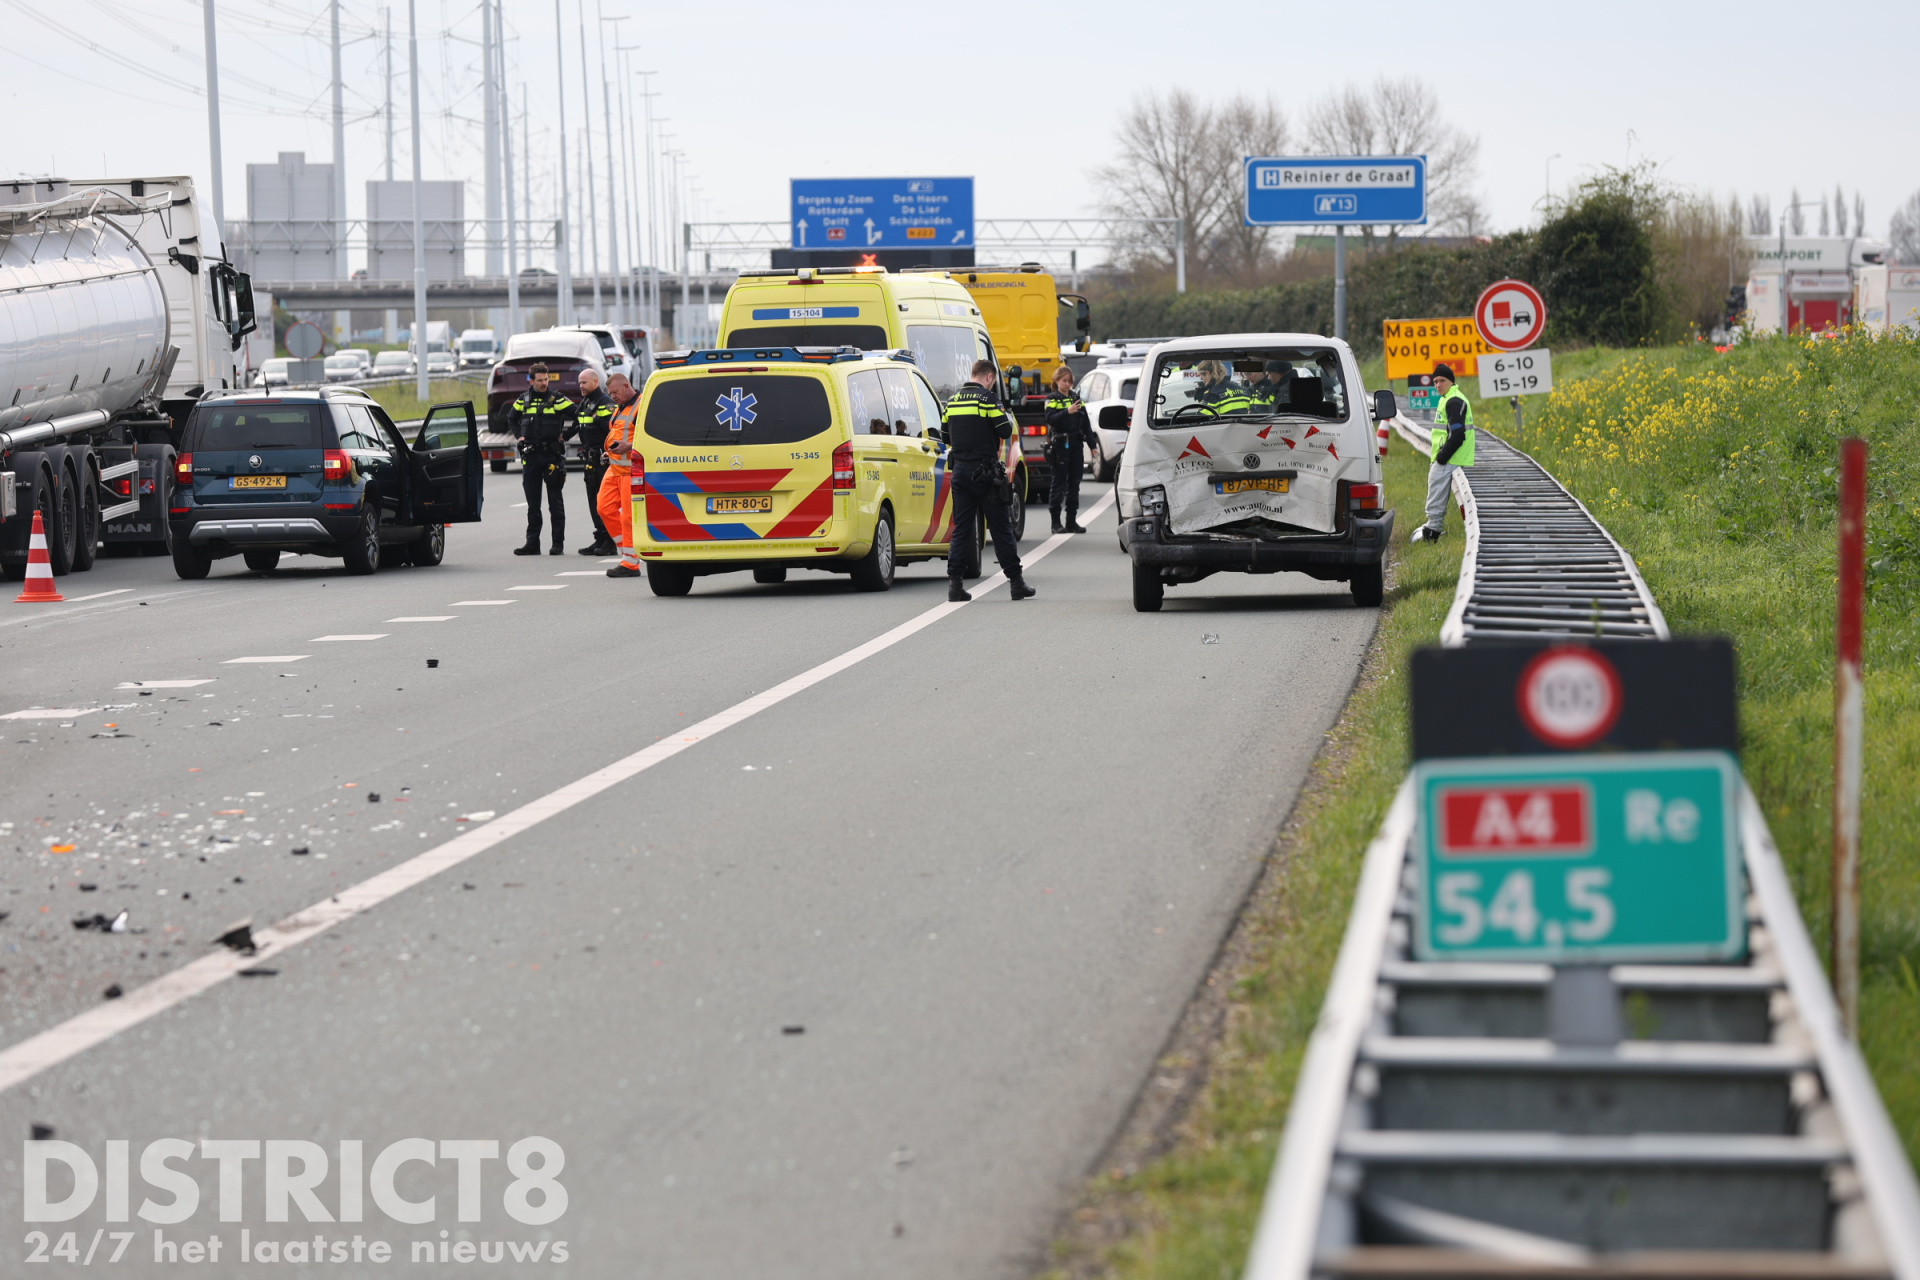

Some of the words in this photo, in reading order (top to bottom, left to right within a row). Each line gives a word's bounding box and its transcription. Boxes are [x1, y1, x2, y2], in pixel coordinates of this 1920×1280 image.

[1284, 171, 1340, 182] Reinier
[1346, 170, 1362, 182] de
[1369, 169, 1410, 182] Graaf
[847, 195, 874, 204] Zoom
[893, 194, 914, 203] Den
[917, 193, 949, 203] Hoorn
[902, 205, 916, 214] De
[918, 205, 941, 214] Lier
[1339, 199, 1353, 210] 13
[808, 206, 864, 215] Rotterdam
[823, 217, 849, 226] Delft
[1386, 321, 1479, 338] Maaslan
[1388, 341, 1430, 360] volg
[1440, 338, 1494, 355] route
[1495, 356, 1534, 373] 6-10
[1493, 375, 1539, 392] 15-19
[890, 386, 909, 409] GGD
[1411, 398, 1431, 408] 54,6
[656, 454, 719, 464] AMBULANCE
[790, 452, 820, 460] 15-345
[1175, 461, 1214, 471] AUTON
[236, 476, 282, 487] GS-492-K
[909, 471, 933, 481] AMBULANCE
[716, 498, 769, 510] HTR-80-G
[1223, 502, 1283, 515] www.auton.nl
[107, 523, 152, 533] MAN
[1472, 791, 1557, 846] A4
[1624, 789, 1700, 843] Re
[1434, 866, 1616, 949] 54,5
